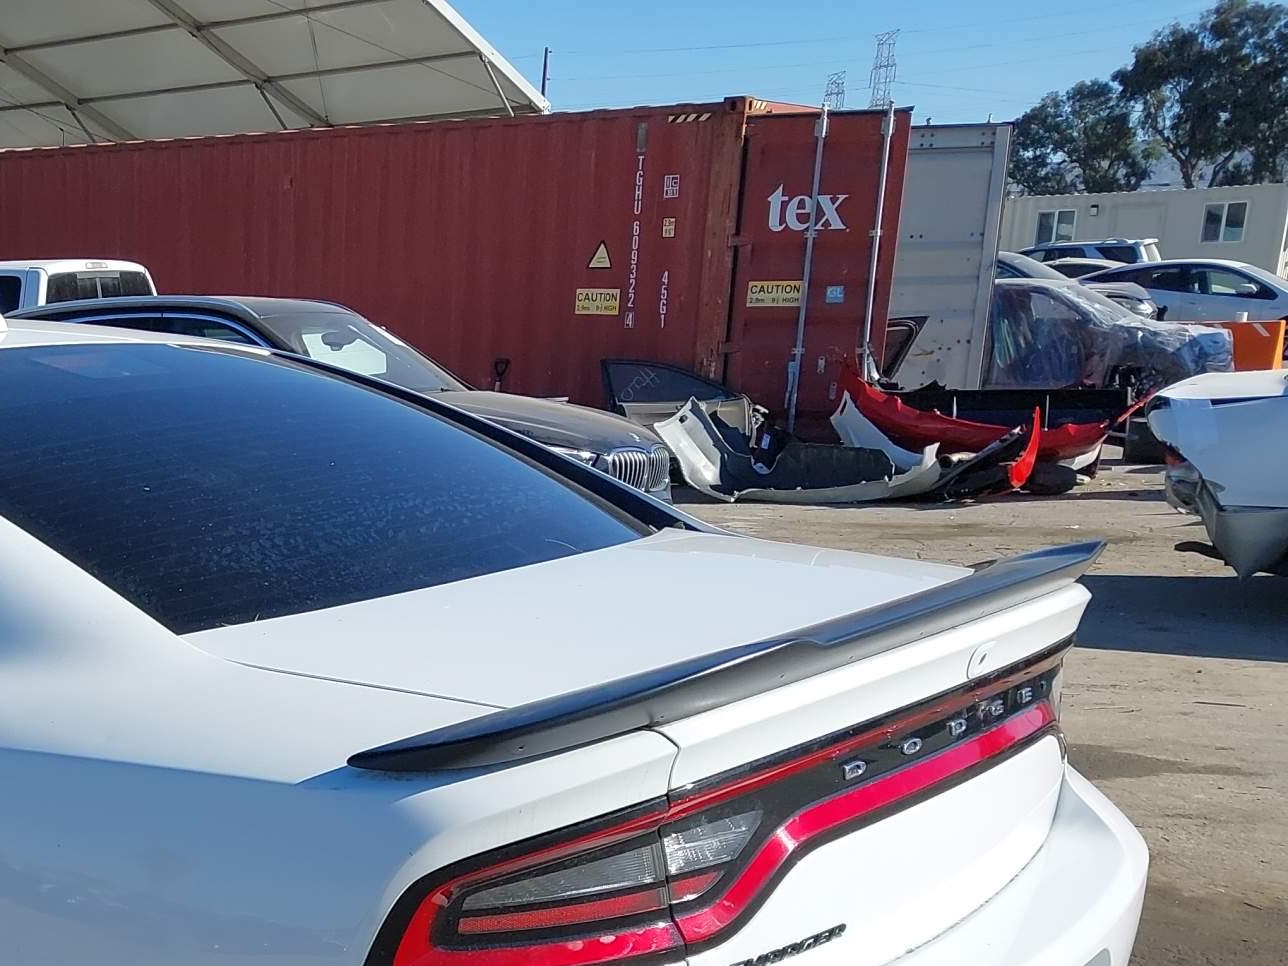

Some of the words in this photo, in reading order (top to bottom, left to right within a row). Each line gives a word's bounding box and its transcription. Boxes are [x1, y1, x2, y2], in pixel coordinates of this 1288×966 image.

[633, 155, 645, 215] TGHU
[767, 183, 849, 232] tex
[627, 220, 640, 308] 609322
[750, 284, 801, 295] CAUTION
[577, 292, 618, 303] CAUTION
[659, 270, 669, 329] 45G1
[843, 686, 1034, 781] DODGE
